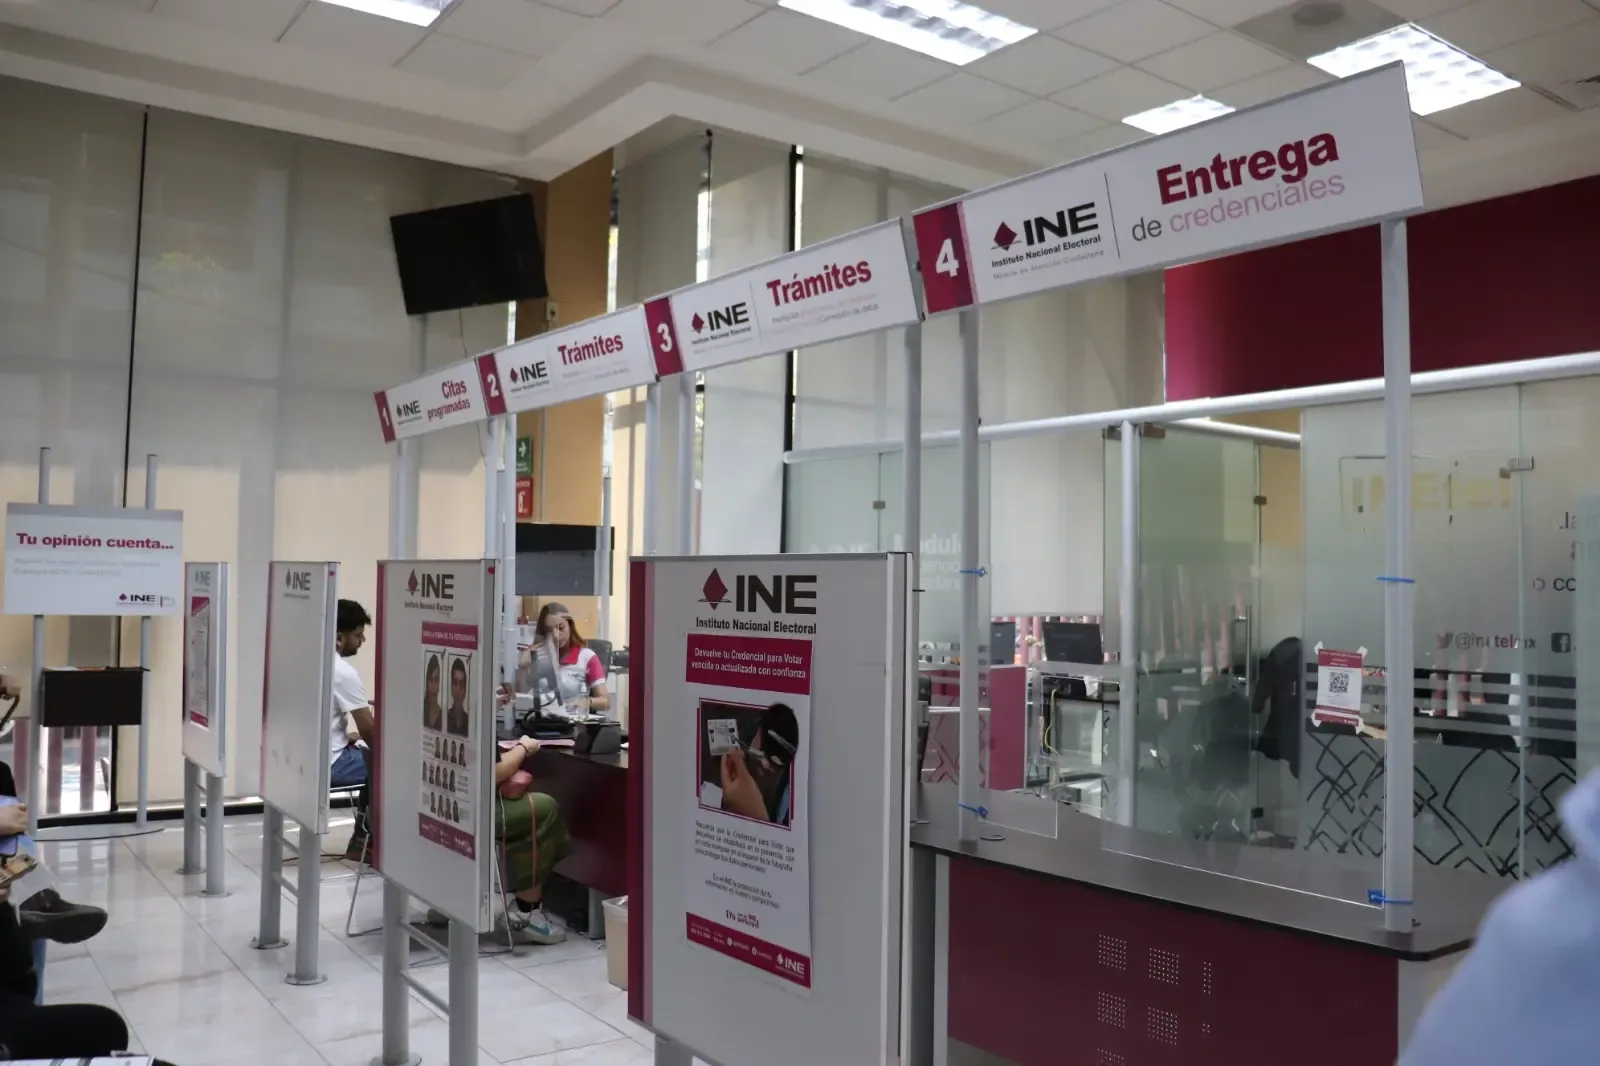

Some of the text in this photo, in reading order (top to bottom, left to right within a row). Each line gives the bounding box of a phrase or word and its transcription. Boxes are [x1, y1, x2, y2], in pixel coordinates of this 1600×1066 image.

[1157, 132, 1339, 205] Entrega
[1131, 174, 1346, 242] de credenciales
[1023, 201, 1099, 247] INE
[935, 238, 960, 278] 4
[992, 234, 1101, 268] Instituto Nacional Electoral
[766, 260, 872, 307] Trámites
[707, 302, 749, 331] INE
[657, 323, 673, 353] 3
[557, 334, 624, 366] Trámites
[519, 361, 547, 382] INE
[441, 380, 467, 399] Citas
[487, 374, 500, 397] 2
[382, 406, 390, 427] 1
[403, 400, 421, 417] INE
[427, 399, 471, 422] programadas
[16, 532, 174, 550] Tu opinión cuenta...
[292, 571, 311, 591] INE
[421, 573, 454, 600] INE
[130, 594, 157, 603] INE
[736, 575, 817, 614] INE
[696, 617, 817, 635] Instituto Nacional Electoral
[694, 647, 803, 666] Devuelve tu Credencial para Votar
[691, 660, 806, 679] vencida o actualizada con confianza
[785, 957, 805, 975] INE
